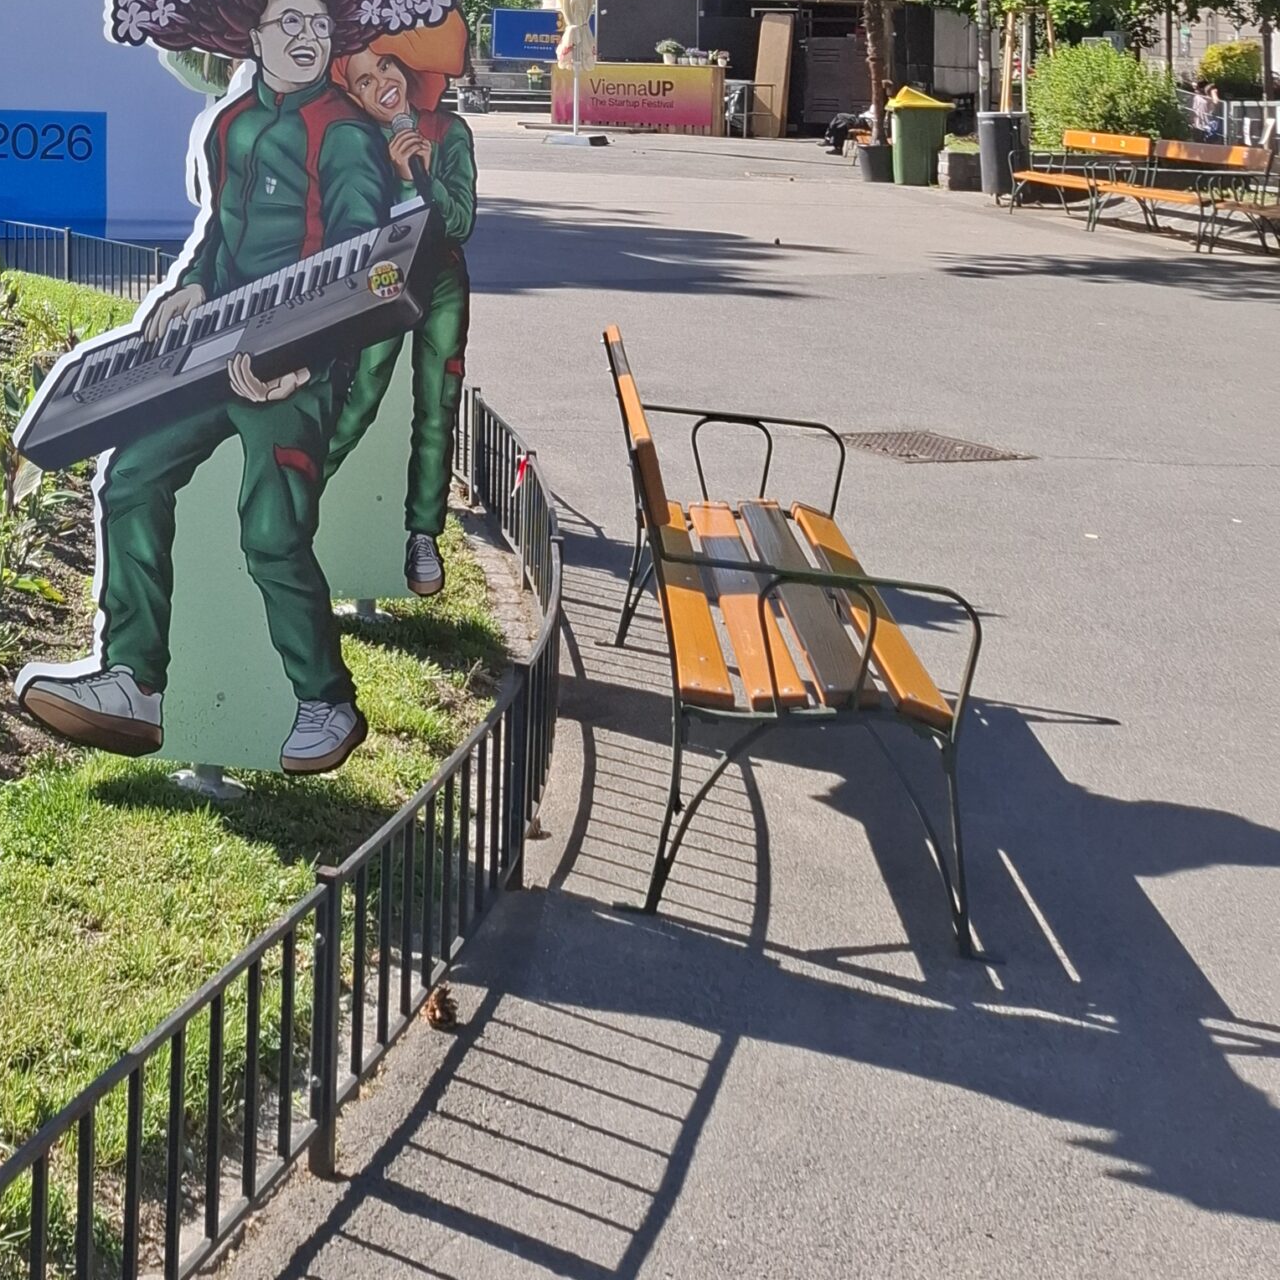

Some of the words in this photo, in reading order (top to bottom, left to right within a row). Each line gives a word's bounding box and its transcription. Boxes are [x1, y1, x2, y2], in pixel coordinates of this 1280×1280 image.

[589, 78, 674, 97] ViennaUP
[590, 97, 607, 106] The
[608, 97, 639, 109] Startup
[641, 98, 674, 109] Festival
[372, 270, 398, 289] POP
